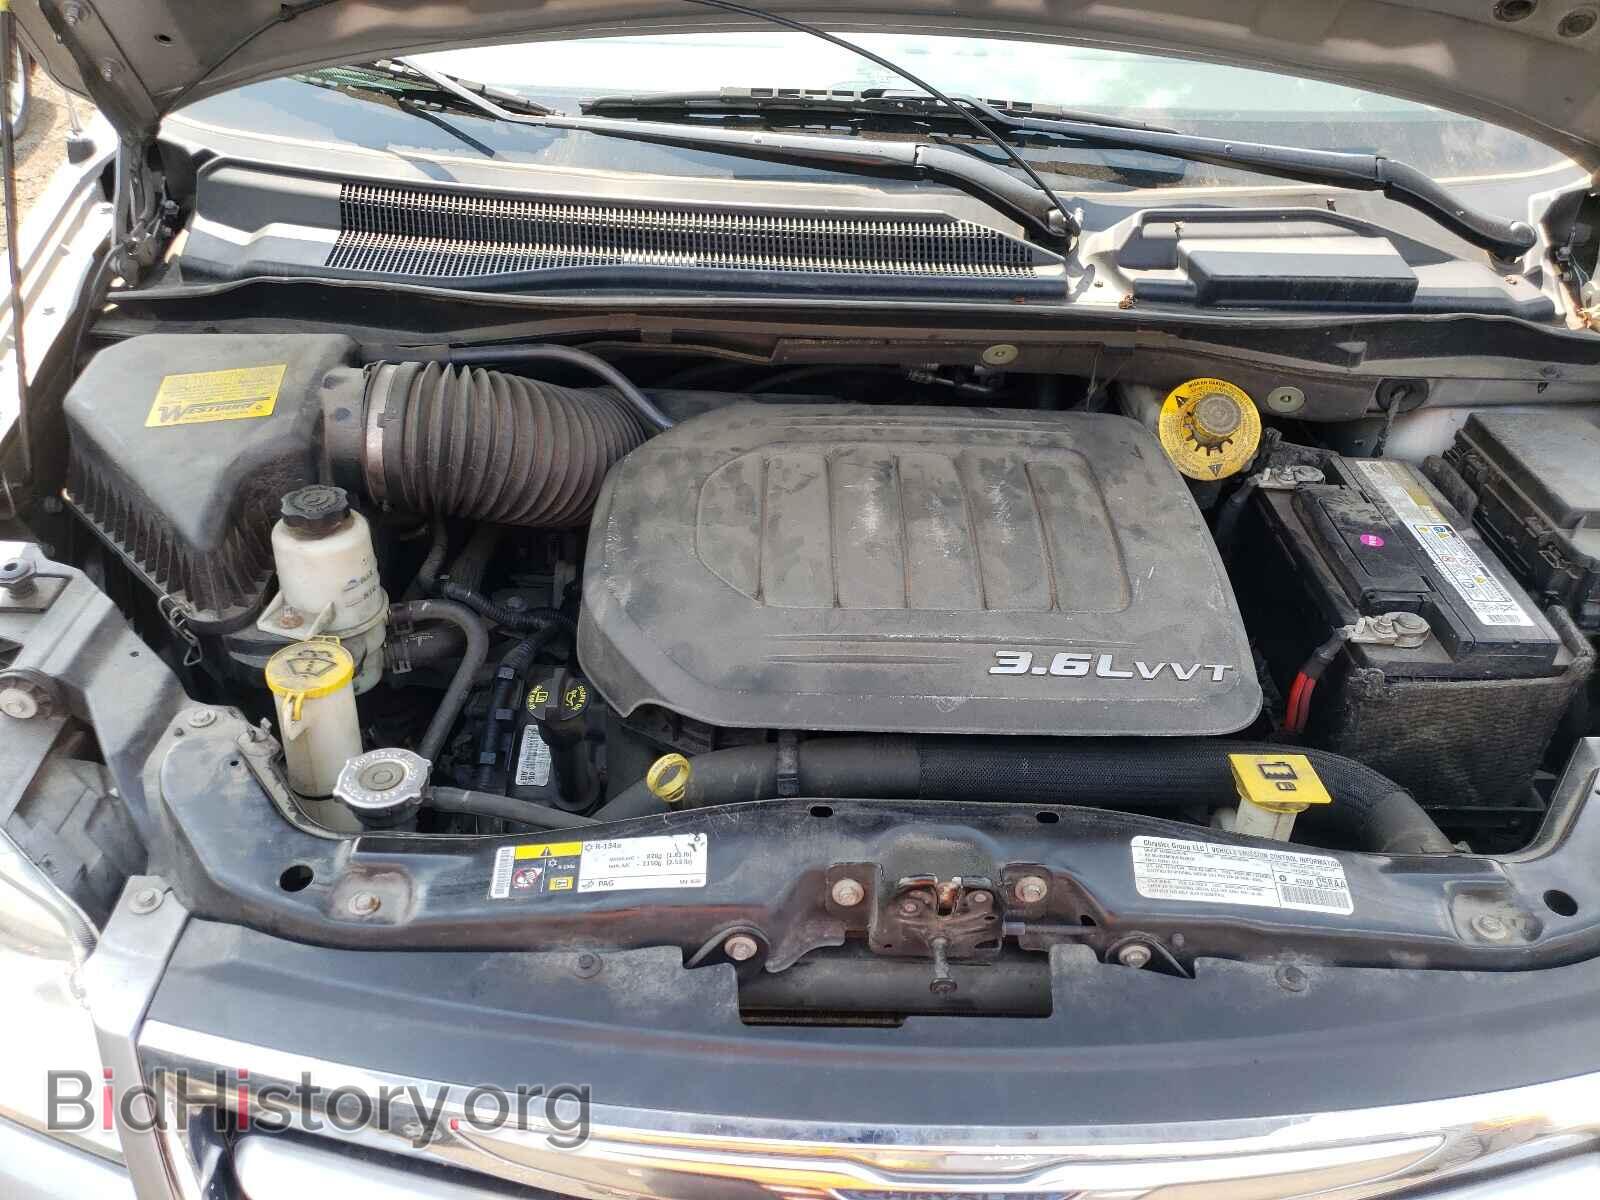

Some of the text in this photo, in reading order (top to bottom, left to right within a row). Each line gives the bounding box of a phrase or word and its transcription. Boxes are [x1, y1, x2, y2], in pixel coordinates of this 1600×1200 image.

[988, 650, 1233, 682] 3.6L VVT
[1143, 839, 1169, 848] Chrysler
[1171, 842, 1191, 851] Group
[1212, 846, 1237, 855] VEHICLE
[1239, 849, 1268, 858] EMISSION
[1270, 853, 1298, 861] CONTROL
[1300, 857, 1343, 867] INFORMATION
